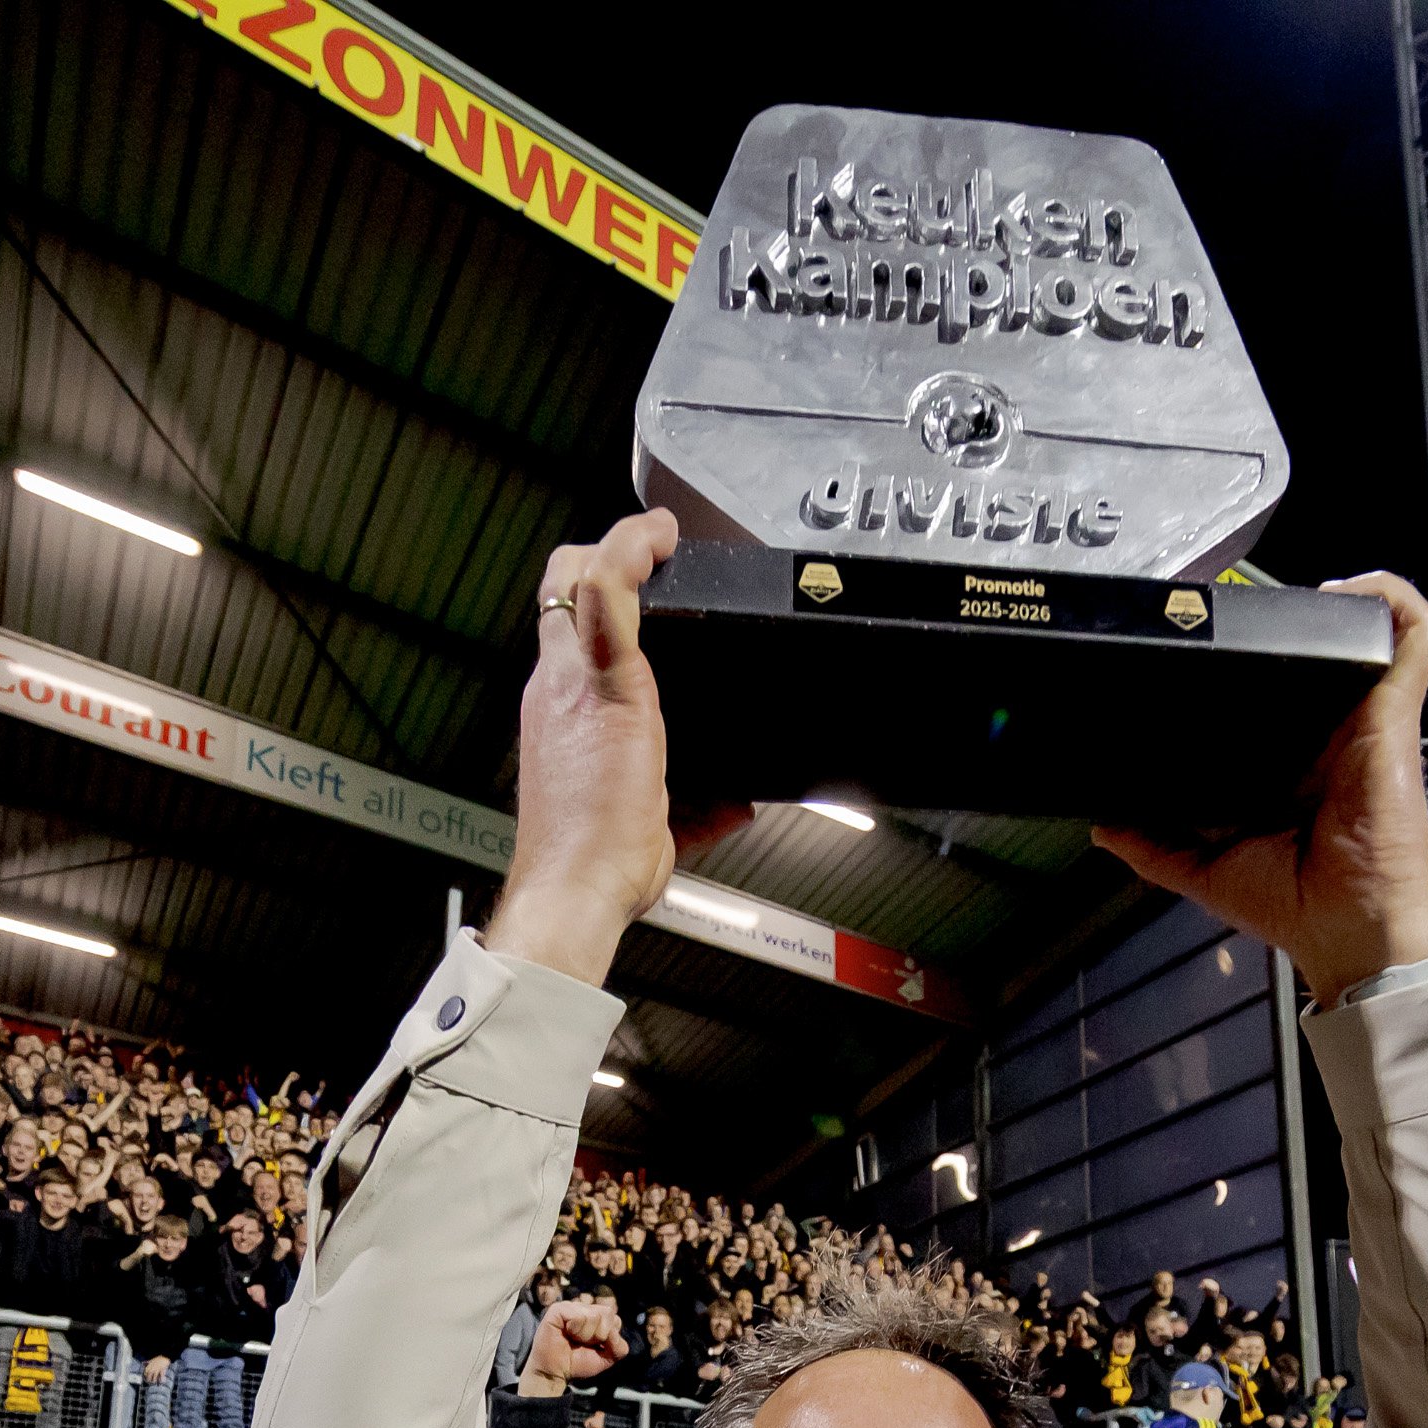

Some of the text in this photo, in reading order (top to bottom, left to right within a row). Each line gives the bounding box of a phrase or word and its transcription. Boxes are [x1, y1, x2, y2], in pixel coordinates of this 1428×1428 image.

[719, 226, 1206, 347] Kampioen
[799, 461, 1123, 547] divisie
[960, 599, 1051, 622] 2025-2026
[965, 574, 1045, 598] Promotie
[247, 739, 345, 802] Kieft
[363, 786, 405, 822] all
[762, 930, 833, 965] werken
